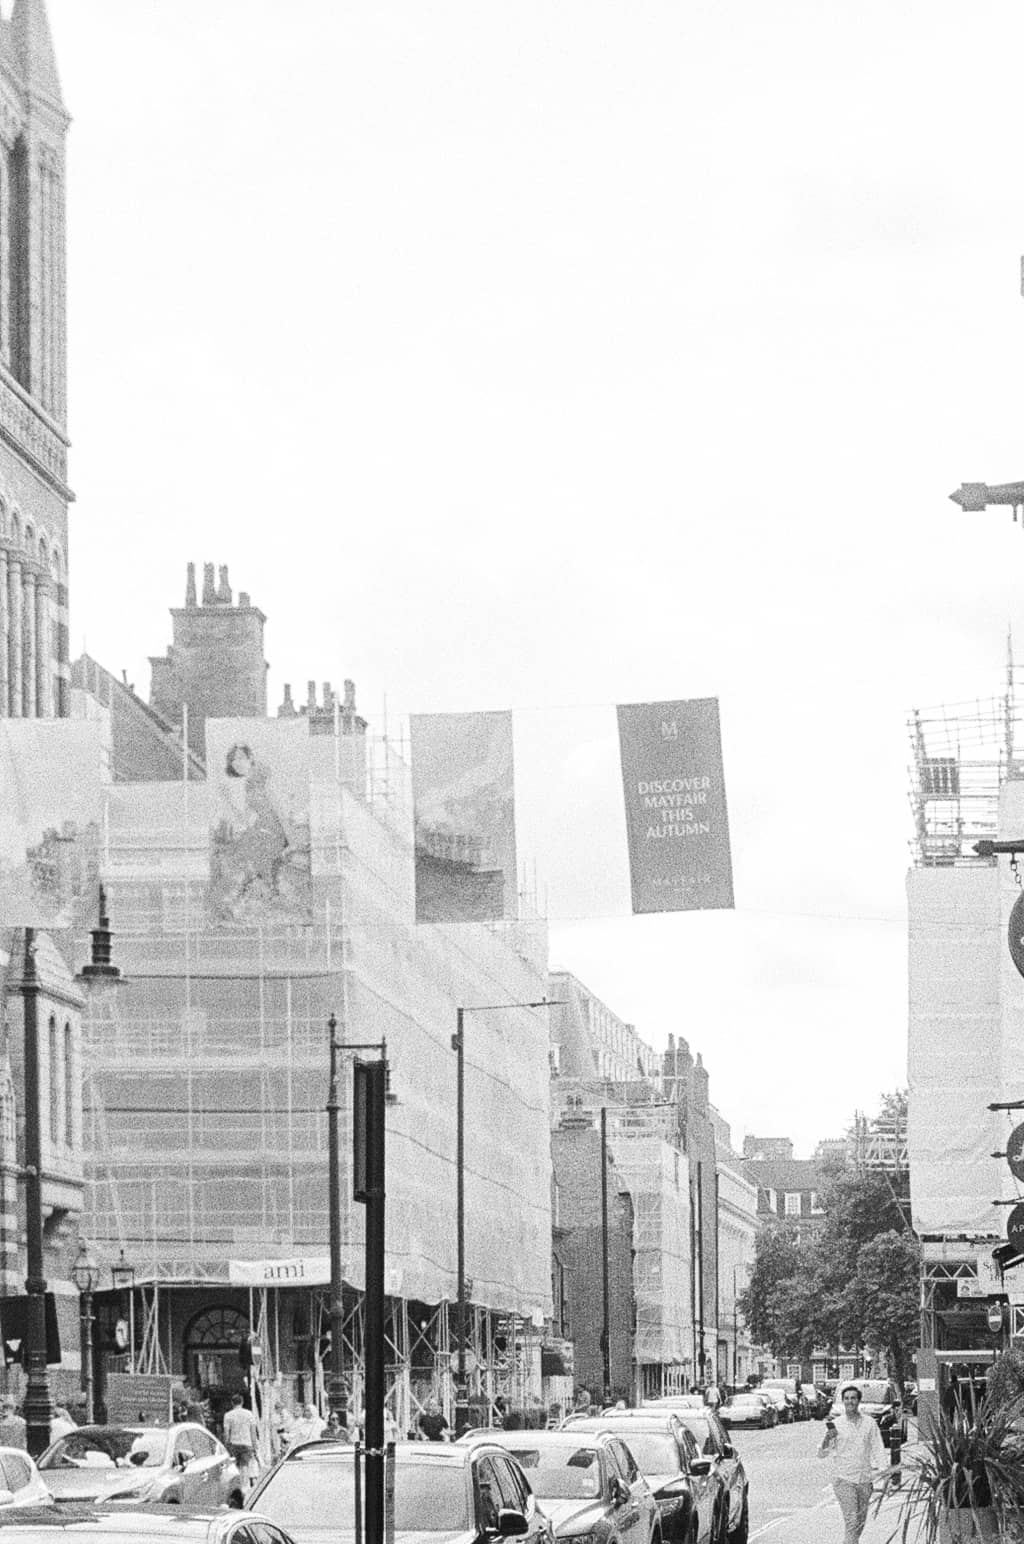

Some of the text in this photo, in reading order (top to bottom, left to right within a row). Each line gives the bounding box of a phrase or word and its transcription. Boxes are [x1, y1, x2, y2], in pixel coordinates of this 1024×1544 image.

[638, 776, 711, 794] DISCOVER
[644, 793, 707, 808] MAYFAIR
[661, 809, 693, 822] THIS
[646, 824, 710, 839] AUTUMN
[263, 1259, 305, 1279] ami
